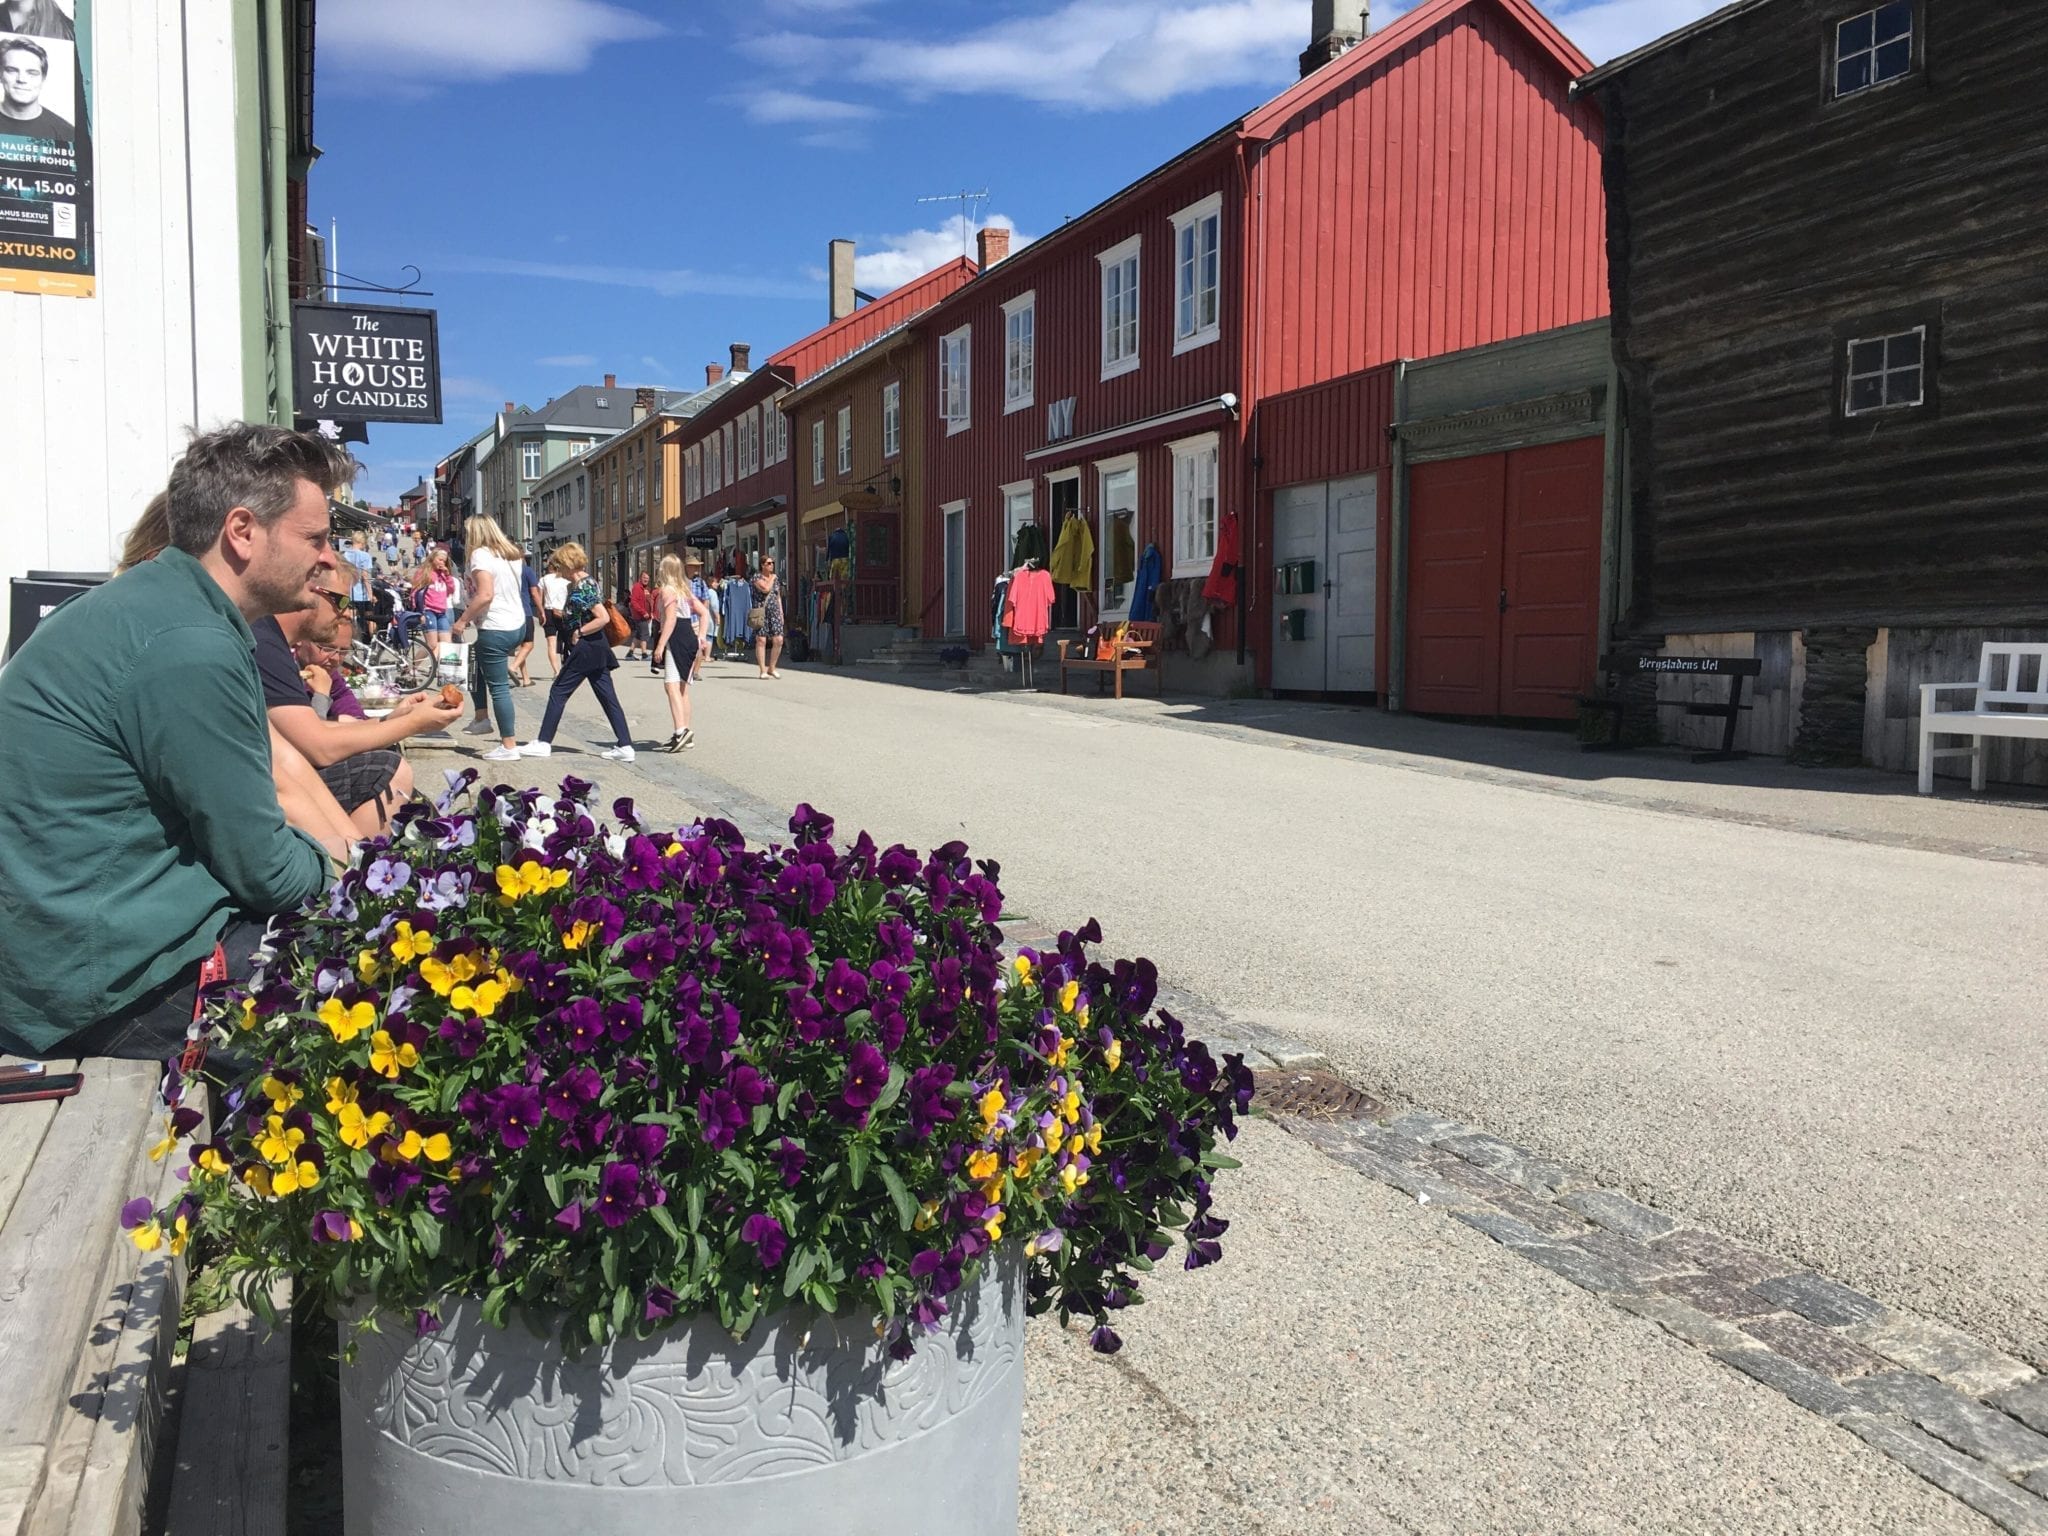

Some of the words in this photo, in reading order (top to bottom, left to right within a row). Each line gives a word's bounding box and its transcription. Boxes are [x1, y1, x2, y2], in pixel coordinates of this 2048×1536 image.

[1, 142, 39, 153] HAUGE
[42, 146, 75, 157] EINBU
[40, 156, 75, 167] ROHDE
[34, 180, 76, 196] 15.00
[21, 211, 49, 220] SEXTUS
[352, 315, 379, 331] The
[308, 333, 425, 362] WHITE
[312, 361, 427, 389] HOUSE
[313, 389, 331, 409] of
[336, 390, 428, 408] CANDLES
[1048, 396, 1077, 441] NY
